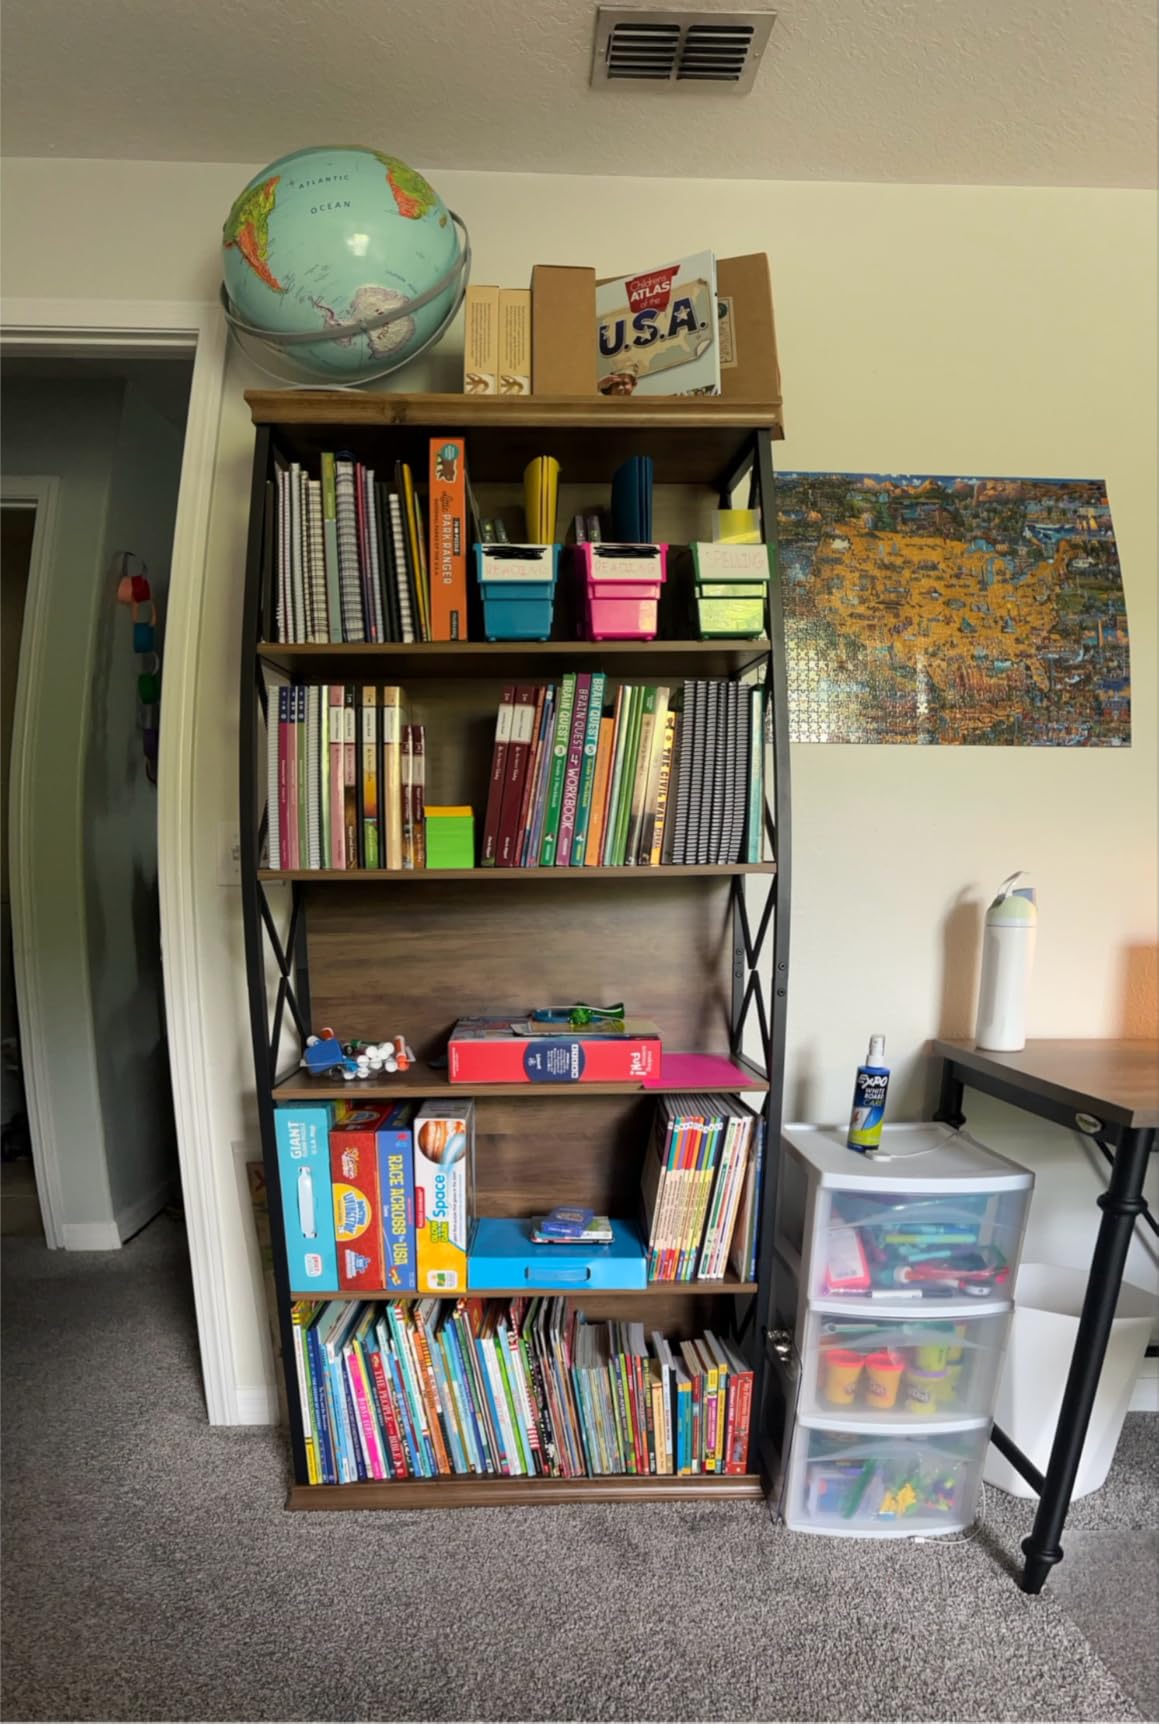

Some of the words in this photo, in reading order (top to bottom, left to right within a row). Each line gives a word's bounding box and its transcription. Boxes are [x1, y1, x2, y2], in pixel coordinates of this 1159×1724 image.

[298, 174, 351, 189] ATLANTIC
[310, 200, 352, 215] OCEAN
[631, 280, 670, 303] ATLAS
[599, 297, 707, 357] U.S.A.
[442, 514, 452, 540] PARK
[442, 542, 452, 584] RANGER
[561, 679, 574, 710] BRAIN
[576, 689, 589, 718] BRAIN
[590, 678, 603, 708] BRAIN
[556, 711, 570, 742] QUEST
[572, 721, 586, 750] QUEST
[586, 709, 599, 740] QUEST
[662, 748, 671, 768] THE
[561, 768, 579, 829] WORKBOOK
[658, 771, 669, 797] CIVIL
[655, 801, 667, 823] WAR
[629, 1052, 647, 1075] FUN!
[858, 1074, 888, 1089] EXPO
[287, 1121, 303, 1160] GIANT
[387, 1155, 405, 1186] RACE
[432, 1175, 449, 1218] Space
[389, 1188, 407, 1235] ACROSS
[393, 1243, 409, 1265] USA
[373, 1369, 384, 1390] THE
[378, 1390, 394, 1424] PEOPLE
[388, 1436, 401, 1460] BIBLE
